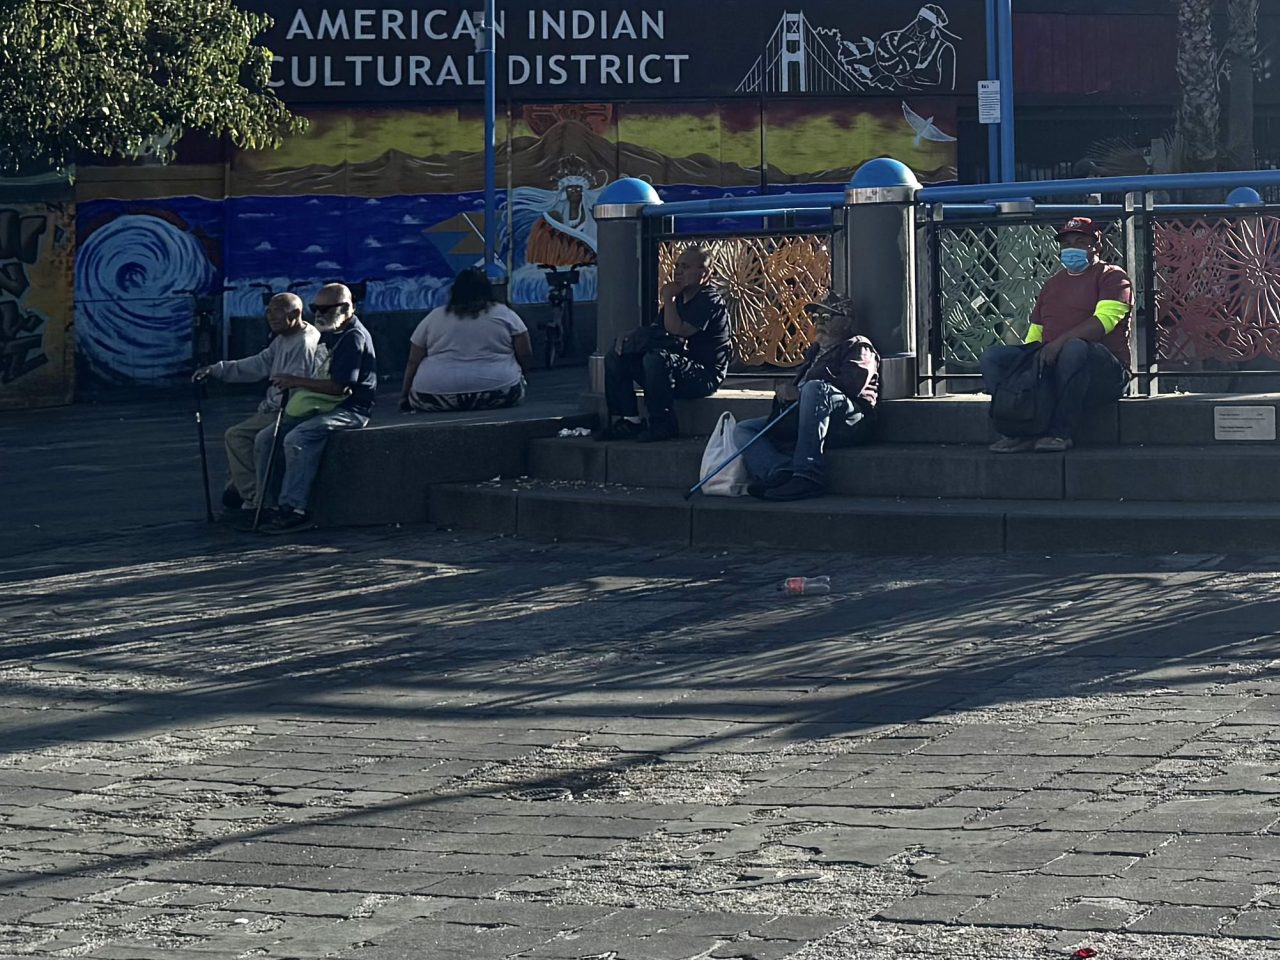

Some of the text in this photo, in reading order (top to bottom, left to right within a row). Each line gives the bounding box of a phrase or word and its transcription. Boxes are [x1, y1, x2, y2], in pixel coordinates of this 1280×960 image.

[528, 10, 664, 40] INDIAN
[265, 55, 689, 87] CULTURAL DISTRICT
